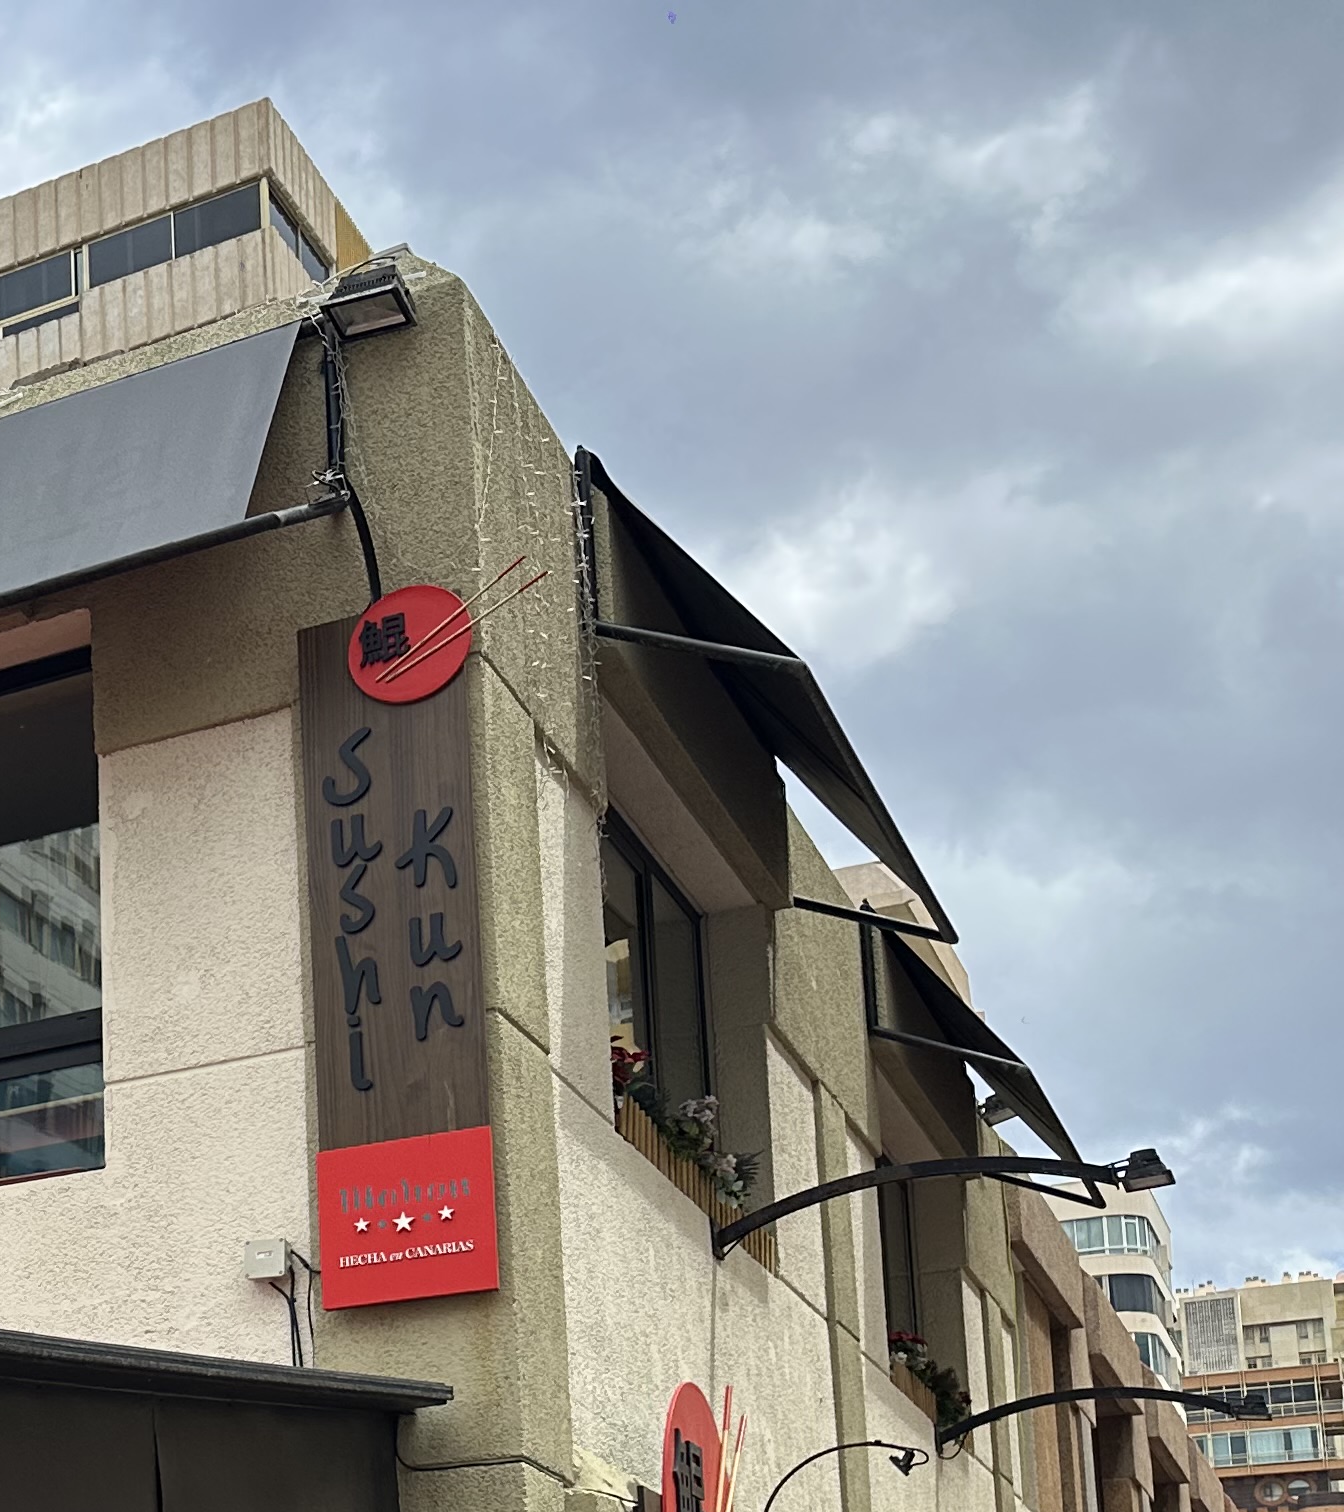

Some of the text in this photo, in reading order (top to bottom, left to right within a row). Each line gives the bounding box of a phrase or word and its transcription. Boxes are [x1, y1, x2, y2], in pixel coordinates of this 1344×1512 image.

[322, 727, 382, 1091] Sushi
[395, 805, 465, 1042] Kun
[339, 1239, 474, 1268] HECHA en CANARIAS
